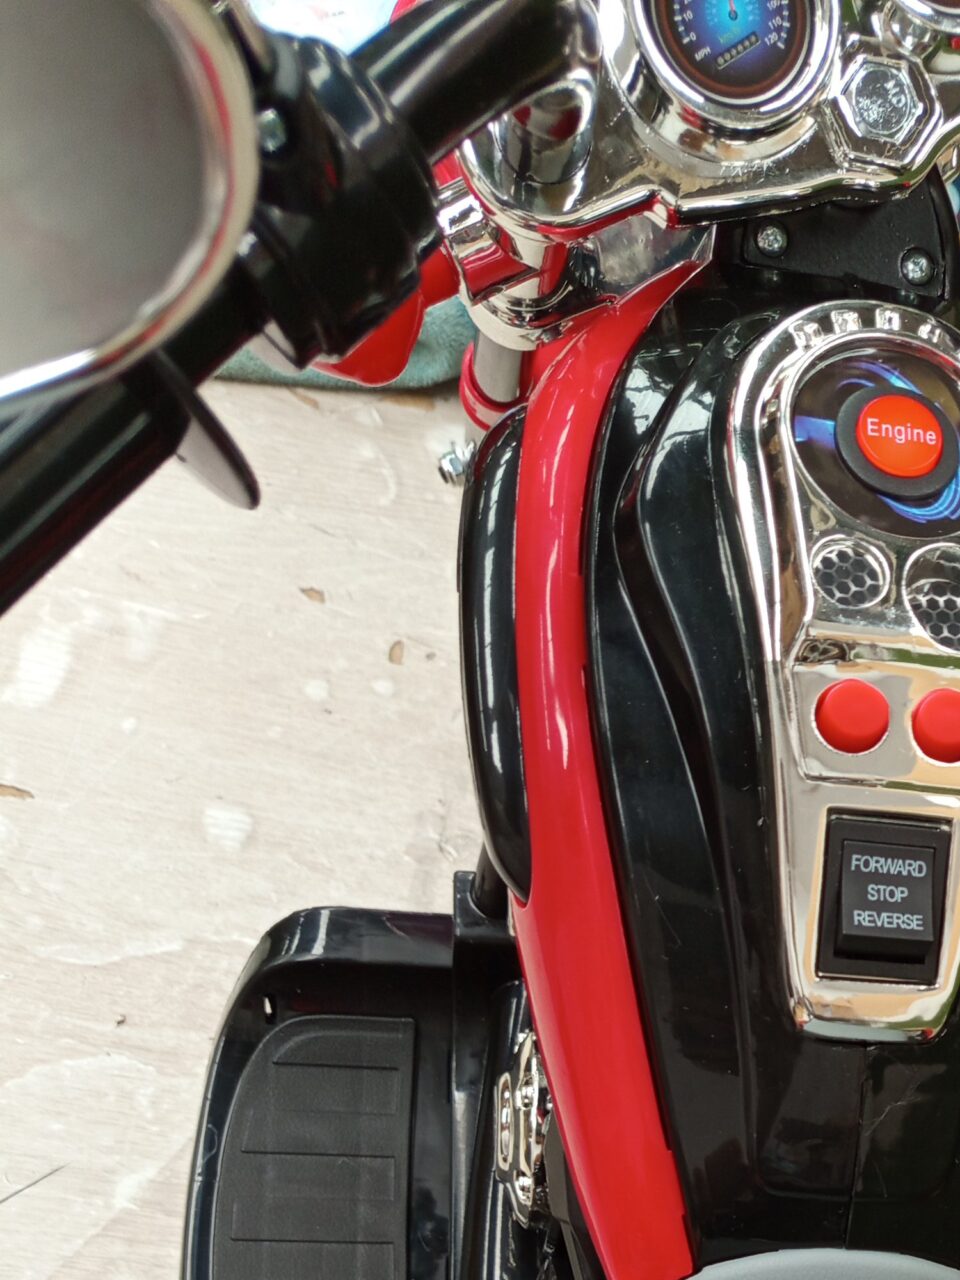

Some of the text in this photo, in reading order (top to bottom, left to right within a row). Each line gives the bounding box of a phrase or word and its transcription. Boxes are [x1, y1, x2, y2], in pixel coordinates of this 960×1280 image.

[683, 10, 693, 21] 10
[768, 16, 782, 30] 110
[764, 32, 779, 46] 120
[694, 46, 712, 62] MPH
[867, 417, 937, 445] Engine
[851, 854, 927, 878] FORWARD
[867, 884, 908, 902] STOP
[853, 910, 924, 930] REVERSE
